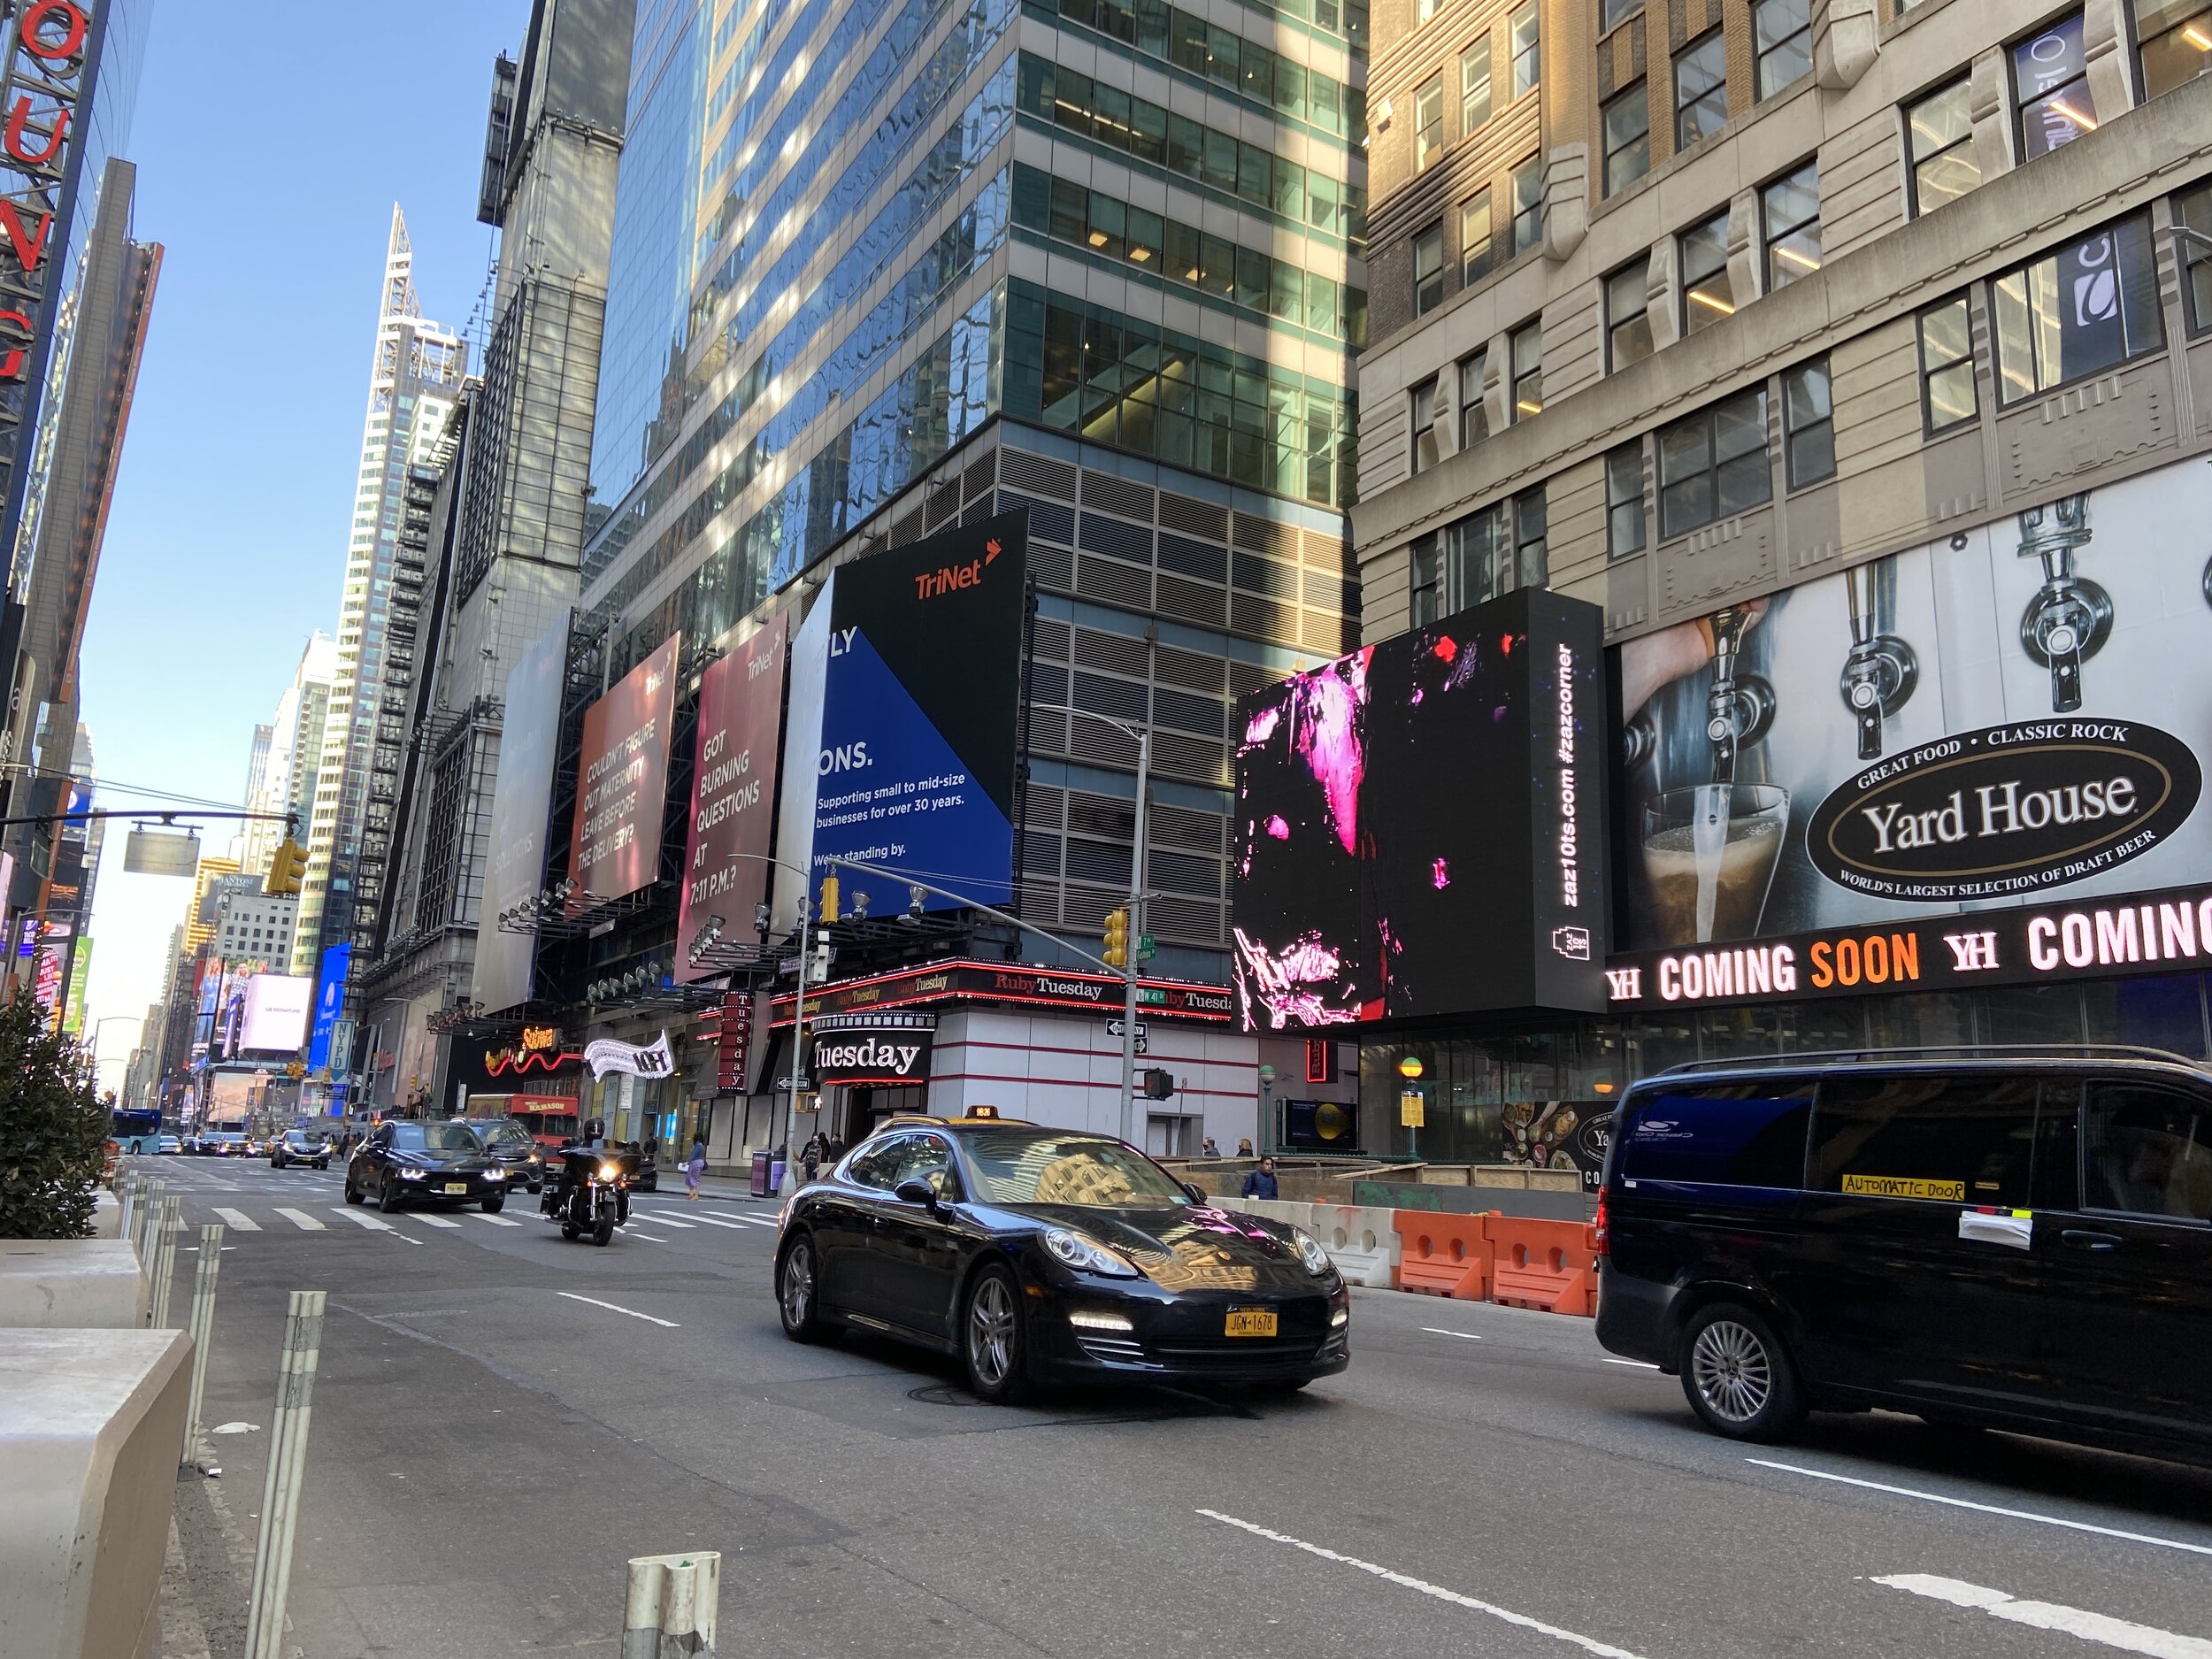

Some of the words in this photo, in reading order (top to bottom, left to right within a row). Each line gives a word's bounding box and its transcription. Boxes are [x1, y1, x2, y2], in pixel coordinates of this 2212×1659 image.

[915, 558, 981, 601] TriNet
[748, 647, 772, 681] TriNet
[1558, 642, 1574, 764] #zazcorner
[588, 742, 625, 783] COULDN'T
[625, 718, 656, 752] FIGURE
[703, 729, 726, 762] GOT
[1858, 756, 1909, 789] GREAT
[1915, 740, 1961, 765] FOOD
[1987, 724, 2066, 746] CLASSIC
[2070, 724, 2129, 742] ROCK
[584, 789, 601, 812] OUT
[600, 756, 645, 803] MATERNITY
[700, 749, 749, 798] BURNING
[818, 790, 872, 810] Supporting
[874, 782, 902, 801] small
[903, 782, 916, 794] to
[918, 772, 965, 791] mid-size
[580, 812, 603, 842] LEAVE
[603, 791, 636, 828] BEFORE
[697, 780, 760, 833] QUESTIONS
[816, 810, 868, 829] businesses
[871, 807, 886, 819] for
[887, 803, 912, 816] over
[914, 798, 929, 811] 30
[932, 795, 964, 811] years.
[1862, 791, 1968, 855] Yard
[1975, 776, 2138, 837] House
[578, 847, 592, 871] THE
[593, 823, 634, 860] DELIVERY?
[693, 843, 707, 870] AT
[844, 845, 888, 863] standing
[890, 842, 906, 856] by.
[1560, 770, 1578, 908] zaz10ts.com
[690, 879, 708, 905] 7:11
[709, 864, 737, 897] P.M.?
[1839, 869, 1893, 894] WORLD'S
[1895, 883, 1957, 897] LARGEST
[1958, 872, 2039, 895] SELECTION
[2041, 867, 2062, 882] OF
[2065, 850, 2113, 878] DRAFT
[2116, 829, 2156, 858] BEER
[915, 974, 949, 993] Tuesday
[994, 975, 1036, 995] Ruby
[1036, 977, 1103, 1001] Tuesday
[1606, 967, 1643, 1001] YH
[1659, 944, 1796, 1002] COMING
[1810, 933, 1919, 987] SOON
[1943, 932, 1999, 971] YH
[852, 987, 880, 1003] Tuesday
[1151, 992, 1158, 1002] 41
[334, 1023, 348, 1068] NYPD
[732, 995, 748, 1086] Tuesday
[814, 1038, 920, 1075] Tuesday
[1845, 1175, 1924, 1194] AUTOMATIC
[1927, 1183, 1964, 1201] DOOR
